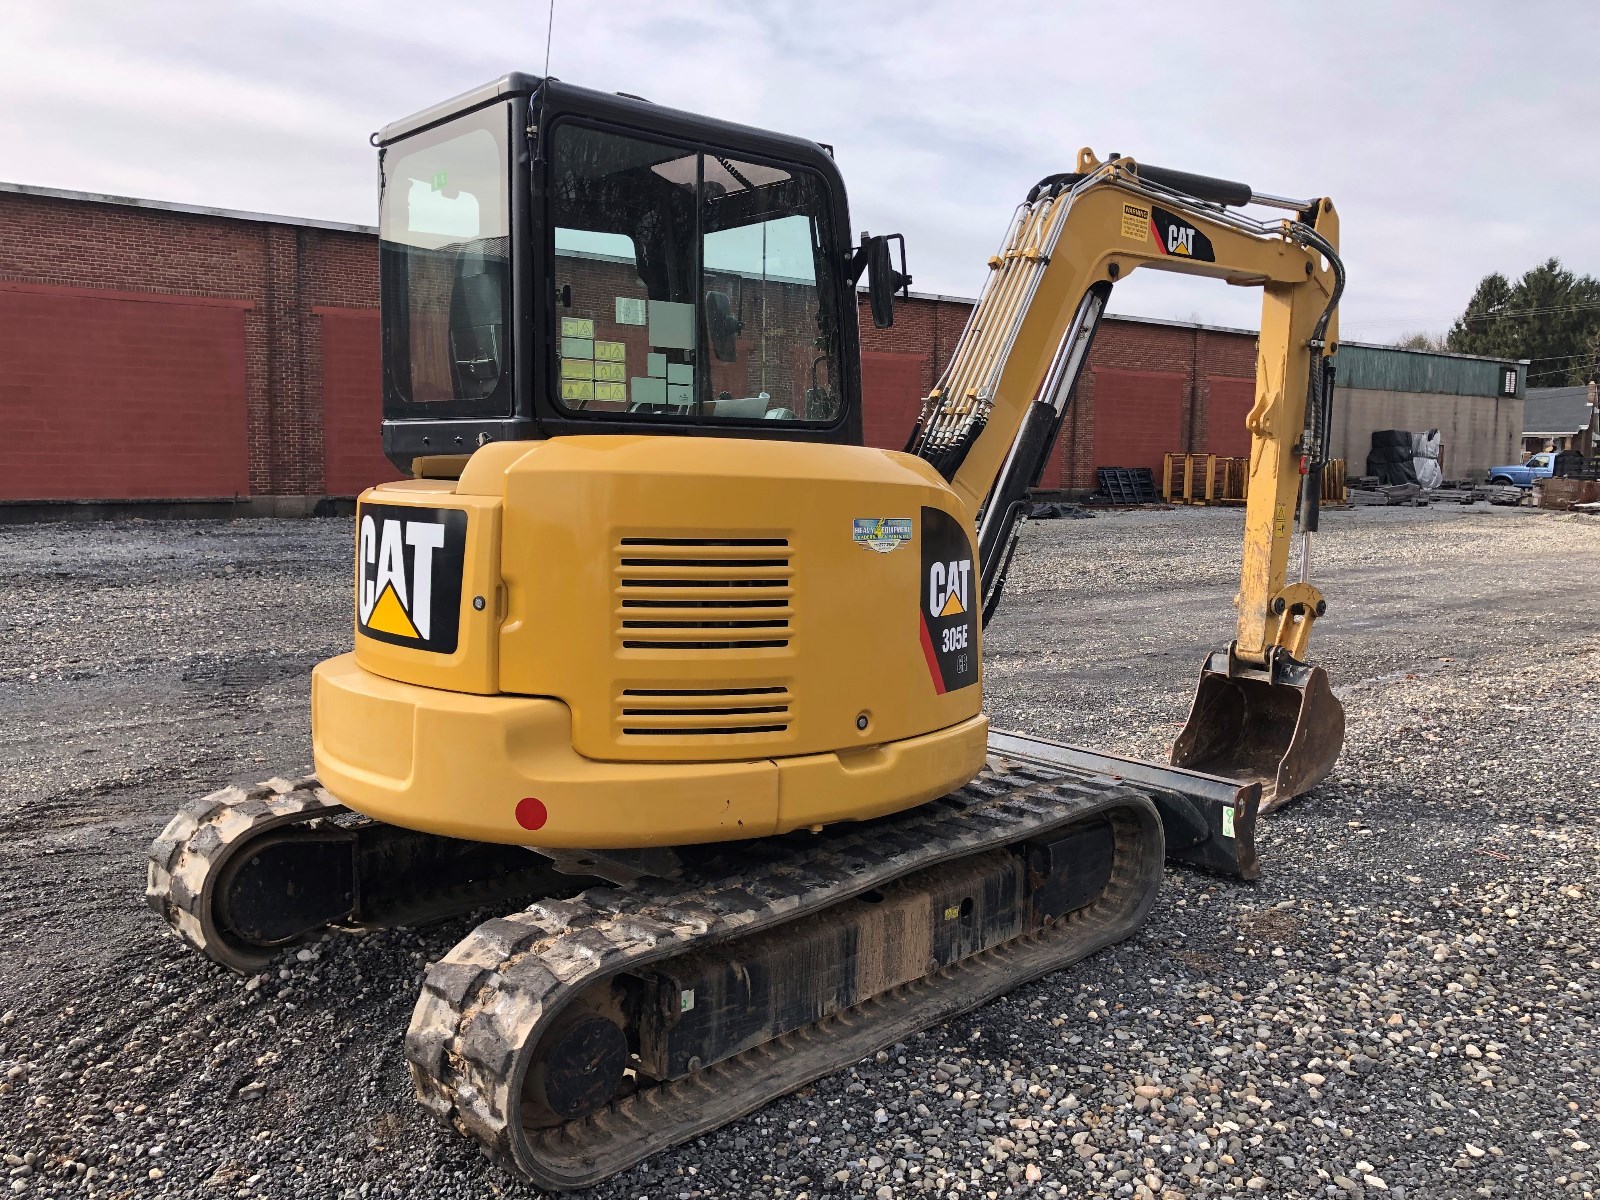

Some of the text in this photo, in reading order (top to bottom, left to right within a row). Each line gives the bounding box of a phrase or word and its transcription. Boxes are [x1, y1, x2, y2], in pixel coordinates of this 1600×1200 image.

[1125, 205, 1148, 219] WARNING
[1168, 225, 1195, 255] CAT
[360, 515, 445, 640] CAT
[930, 560, 970, 618] CAT
[942, 624, 968, 653] 305E
[957, 653, 968, 674] CR
